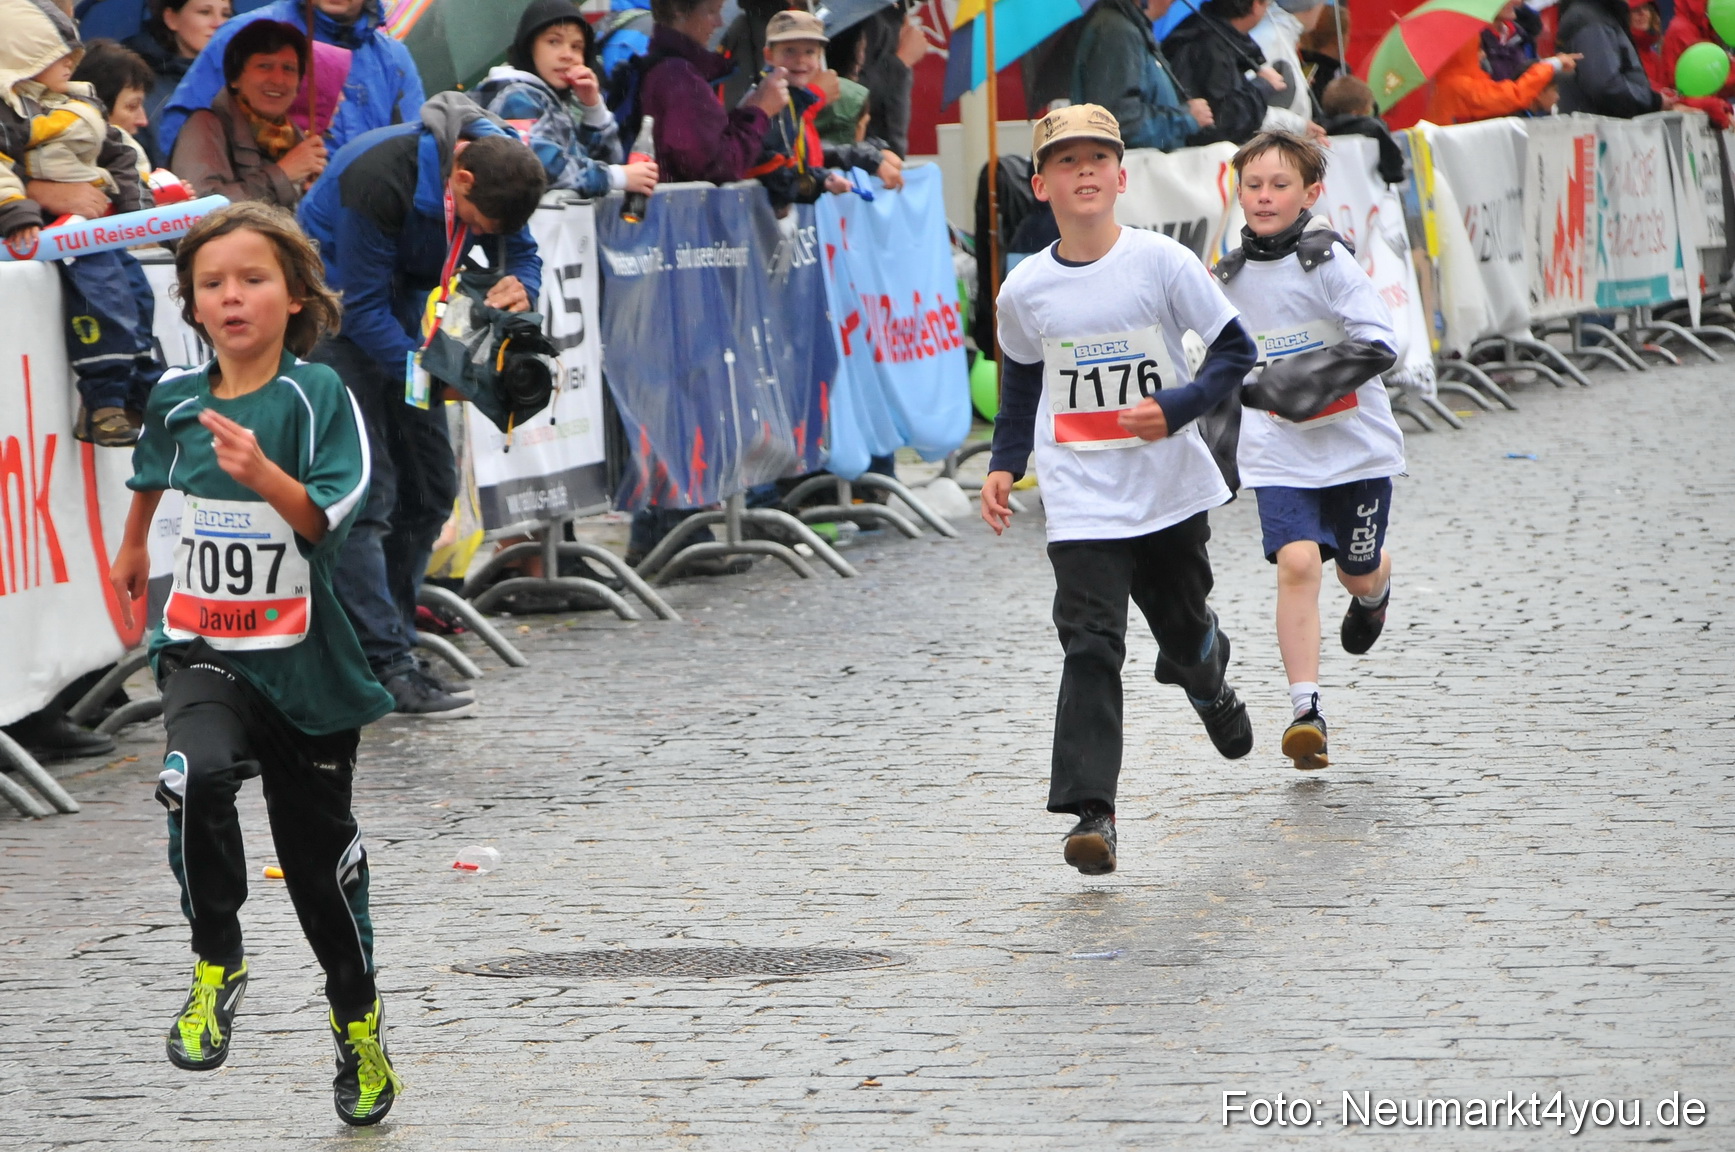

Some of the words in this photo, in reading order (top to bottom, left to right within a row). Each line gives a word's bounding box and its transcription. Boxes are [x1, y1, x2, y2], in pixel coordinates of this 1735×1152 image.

[53, 230, 89, 251] TUI
[94, 212, 204, 245] ReiseCente
[1075, 341, 1129, 358] BOCK
[1265, 331, 1310, 350] BOCK
[1059, 359, 1163, 408] 7176
[0, 354, 69, 597] nk
[194, 510, 252, 528] BOCK
[181, 537, 287, 595] 7097
[200, 606, 257, 630] David
